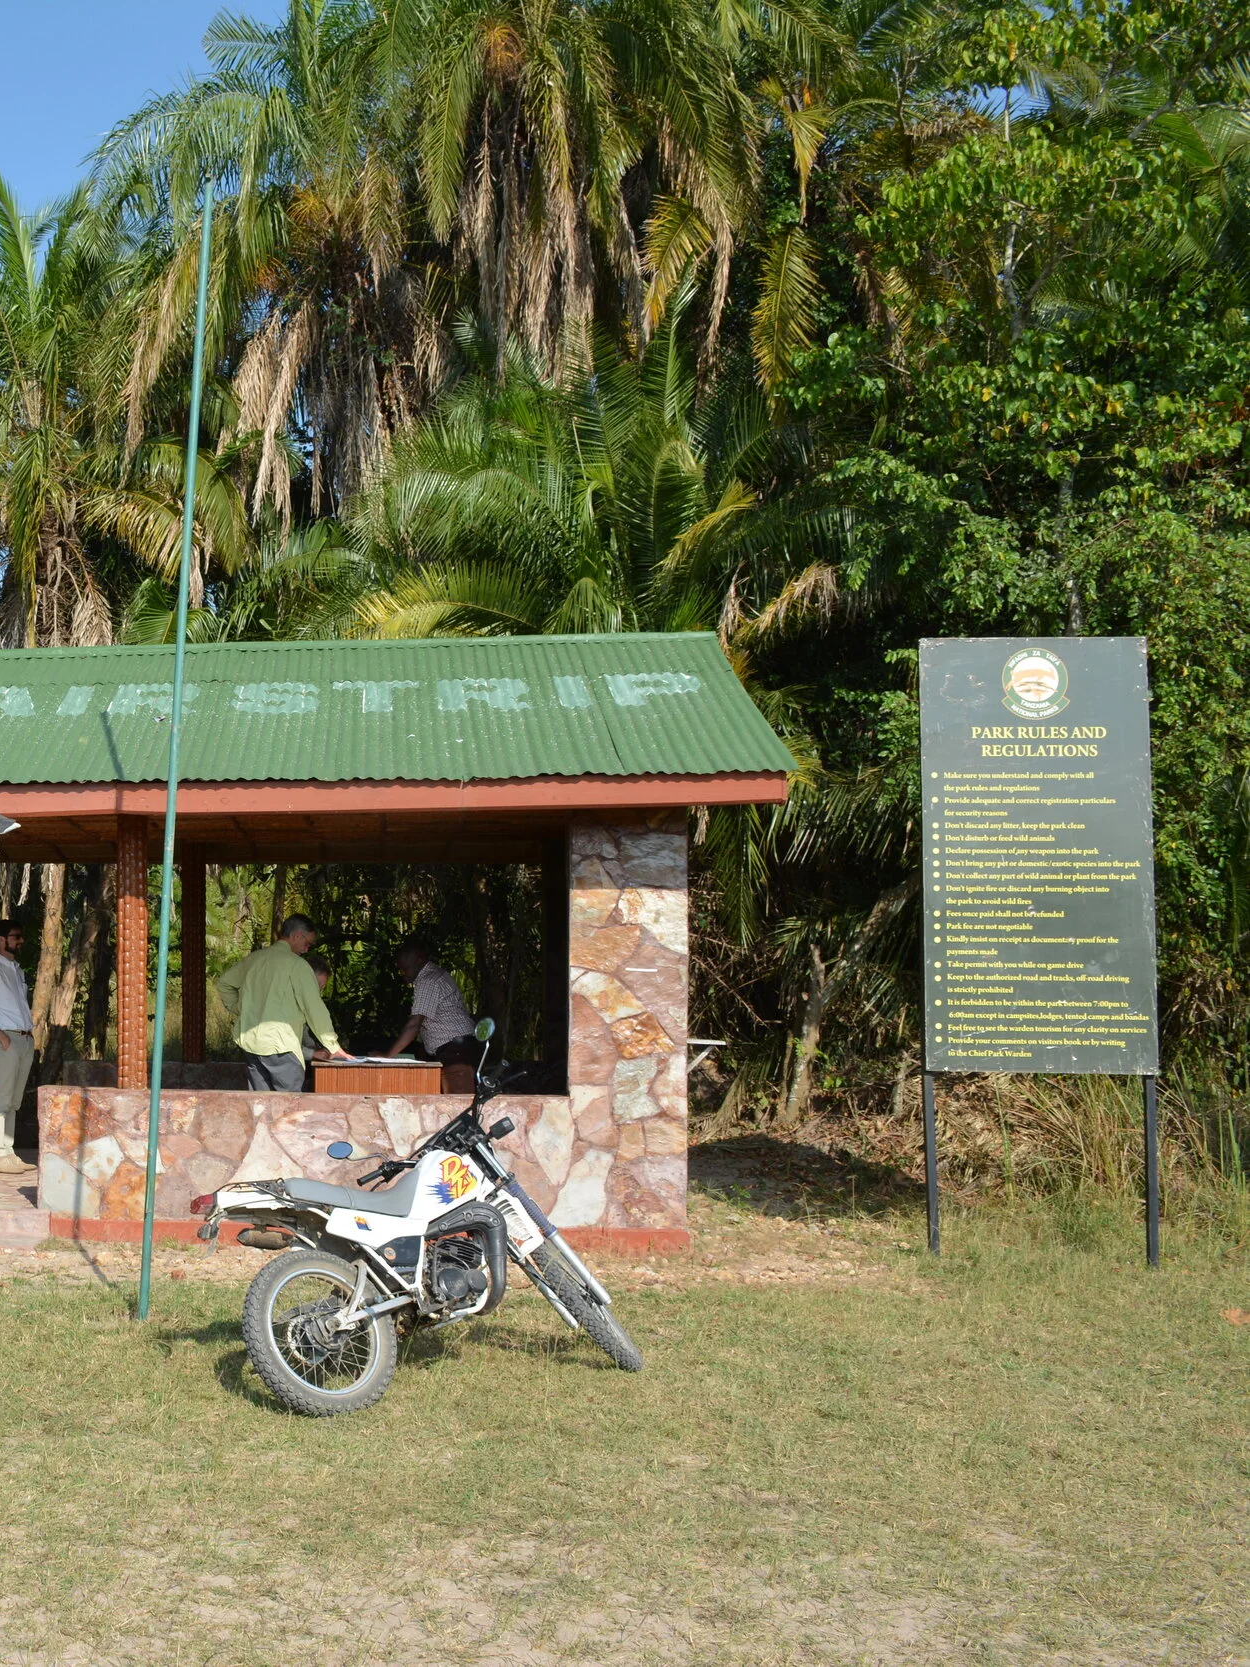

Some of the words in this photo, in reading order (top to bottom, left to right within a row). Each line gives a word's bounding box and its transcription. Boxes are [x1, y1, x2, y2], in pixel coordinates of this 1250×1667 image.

[971, 726, 1013, 739] PARK
[1018, 726, 1068, 739] RULES
[1071, 726, 1107, 739] AND
[981, 744, 1098, 757] REGULATIONS
[943, 771, 962, 779] Make
[1031, 771, 1043, 779] and
[1044, 772, 1069, 781] comply
[1068, 771, 1085, 779] with
[1085, 771, 1094, 779] all
[955, 784, 971, 793] park
[1002, 784, 1040, 793] regulations
[972, 797, 1003, 806] adequate
[1040, 797, 1079, 806] registration
[1080, 797, 1116, 805] particulars
[955, 810, 983, 818] security
[964, 821, 989, 829] discard
[1020, 822, 1038, 831] keep
[1049, 822, 1067, 831] park
[945, 834, 964, 842] Don't
[964, 834, 989, 842] disturb
[998, 834, 1013, 842] feed
[1013, 834, 1031, 842] wild
[971, 848, 1007, 856] possession
[1071, 847, 1082, 855] the
[1083, 847, 1099, 857] park
[945, 859, 965, 867] Don't
[965, 859, 984, 869] bring
[997, 860, 1008, 869] pet
[1070, 861, 1096, 869] species
[1124, 860, 1141, 869] park
[965, 872, 988, 880] collect
[1000, 873, 1015, 881] part
[1023, 872, 1039, 880] wild
[1040, 872, 1063, 880] animal
[1071, 872, 1090, 882] plant
[1089, 872, 1108, 880] from
[1119, 872, 1137, 882] park
[963, 885, 984, 894] ignite
[983, 884, 998, 892] fire
[1045, 885, 1074, 895] burning
[1073, 885, 1094, 894] object
[956, 897, 973, 906] park
[980, 897, 1001, 905] avoid
[1001, 897, 1016, 905] wild
[1017, 897, 1032, 905] fires
[979, 910, 994, 919] paid
[995, 910, 1013, 918] shall
[1033, 910, 1064, 918] refunded
[946, 922, 962, 930] Park
[998, 923, 1033, 932] negotiable
[946, 935, 969, 944] Kindly
[998, 936, 1022, 945] receipt
[1076, 937, 1094, 945] proof
[1094, 936, 1107, 944] for
[1107, 936, 1118, 944] the
[946, 949, 979, 957] payments
[979, 948, 998, 956] made
[946, 960, 964, 968] Take
[964, 961, 988, 970] permit
[1047, 963, 1065, 971] game
[1064, 961, 1084, 969] drive
[947, 973, 965, 982] Keep
[973, 973, 985, 981] the
[985, 973, 1023, 981] authorized
[1076, 974, 1104, 982] off-road
[1104, 974, 1130, 984] driving
[954, 986, 979, 995] strictly
[978, 986, 1014, 995] prohibited
[961, 998, 994, 1006] forbidden
[1035, 999, 1046, 1007] the
[1093, 1000, 1120, 1009] 7:00pm
[948, 1011, 974, 1019] 6:00am
[975, 1012, 997, 1021] except
[1064, 1012, 1088, 1020] tented
[1087, 1014, 1112, 1022] camps
[1111, 1013, 1126, 1021] and
[1125, 1013, 1150, 1021] bandas
[948, 1024, 963, 1032] Feel
[997, 1024, 1008, 1032] the
[1009, 1024, 1034, 1032] warden
[1060, 1025, 1073, 1033] for
[1086, 1025, 1109, 1034] clarity
[948, 1036, 974, 1044] Provide
[1064, 1038, 1082, 1046] book
[1100, 1039, 1126, 1048] writing
[956, 1049, 968, 1057] the
[968, 1049, 987, 1057] Chief
[986, 1049, 1004, 1057] Park
[1004, 1050, 1032, 1058] Warden
